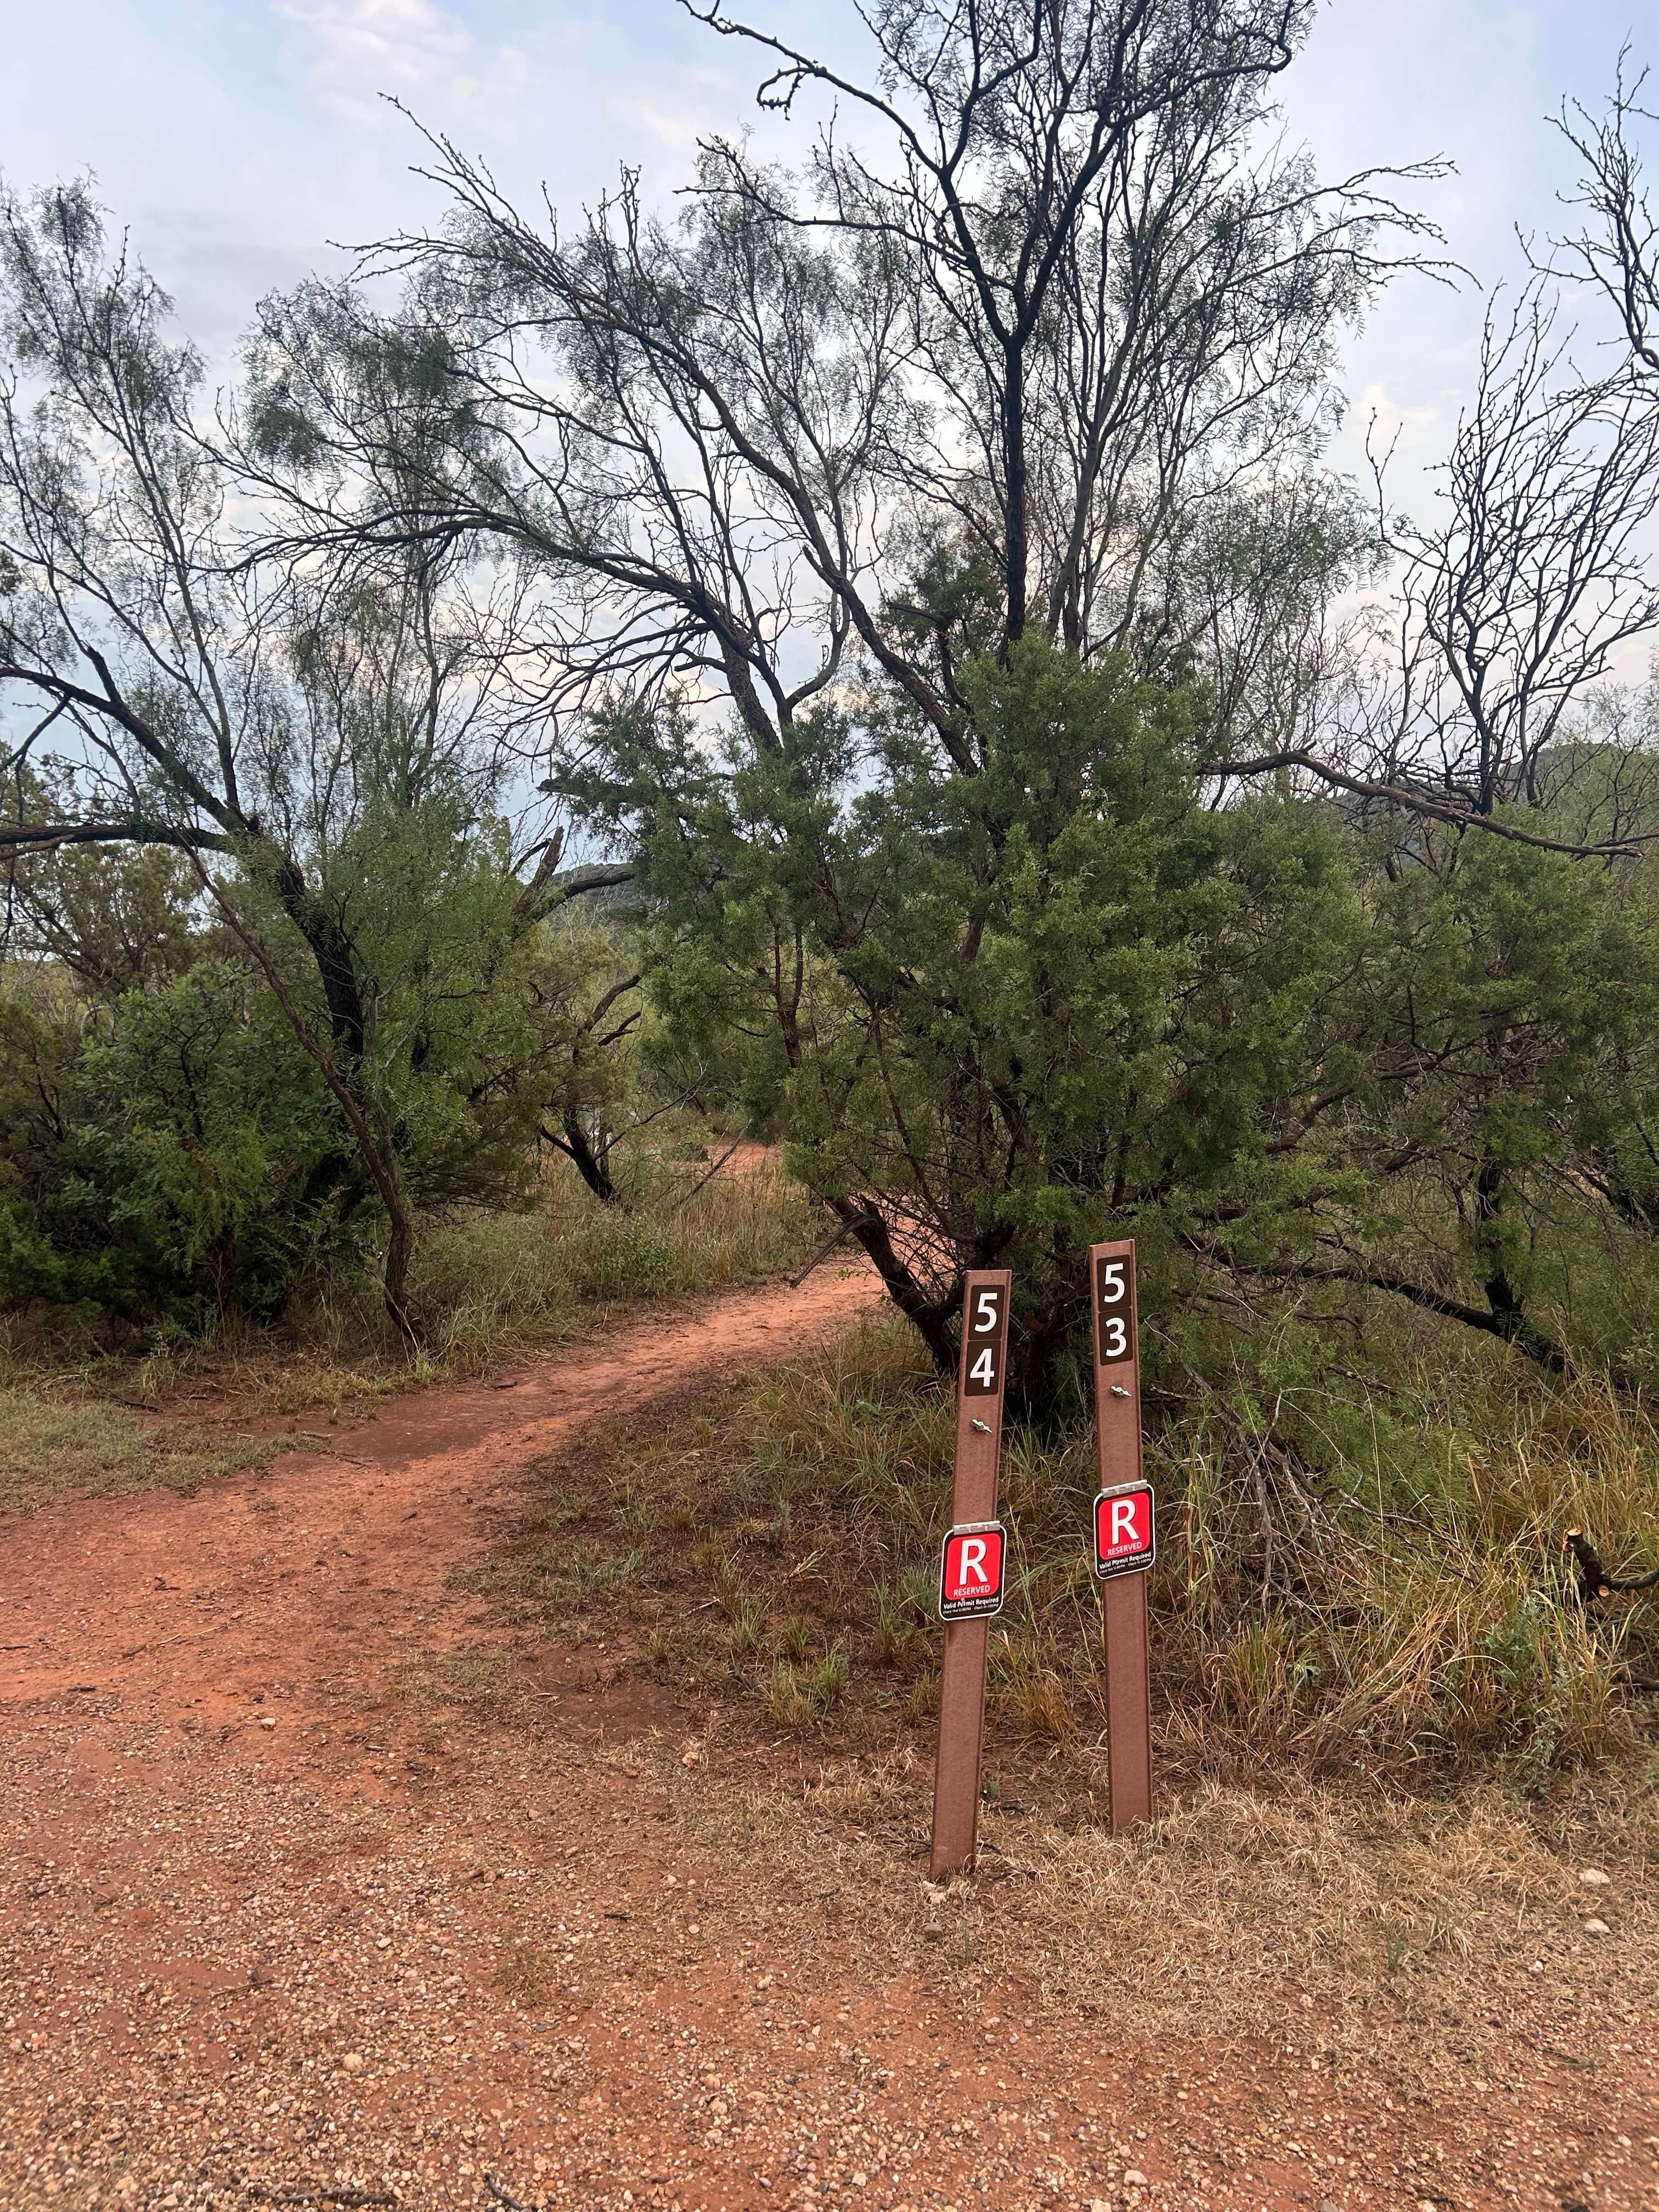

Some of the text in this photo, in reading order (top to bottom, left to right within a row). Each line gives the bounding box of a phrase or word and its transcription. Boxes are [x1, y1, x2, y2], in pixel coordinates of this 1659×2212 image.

[1104, 1263, 1125, 1303] 5
[974, 1293, 998, 1332] 5
[1105, 1317, 1127, 1357] 3
[969, 1348, 995, 1387] 4
[1111, 1499, 1139, 1545] R
[959, 1538, 988, 1585] R
[1099, 1561, 1111, 1570] Valid
[1129, 1551, 1151, 1561] Required
[1107, 1541, 1142, 1556] RESERVED
[953, 1584, 990, 1597] RESERVED
[976, 1596, 999, 1606] Required
